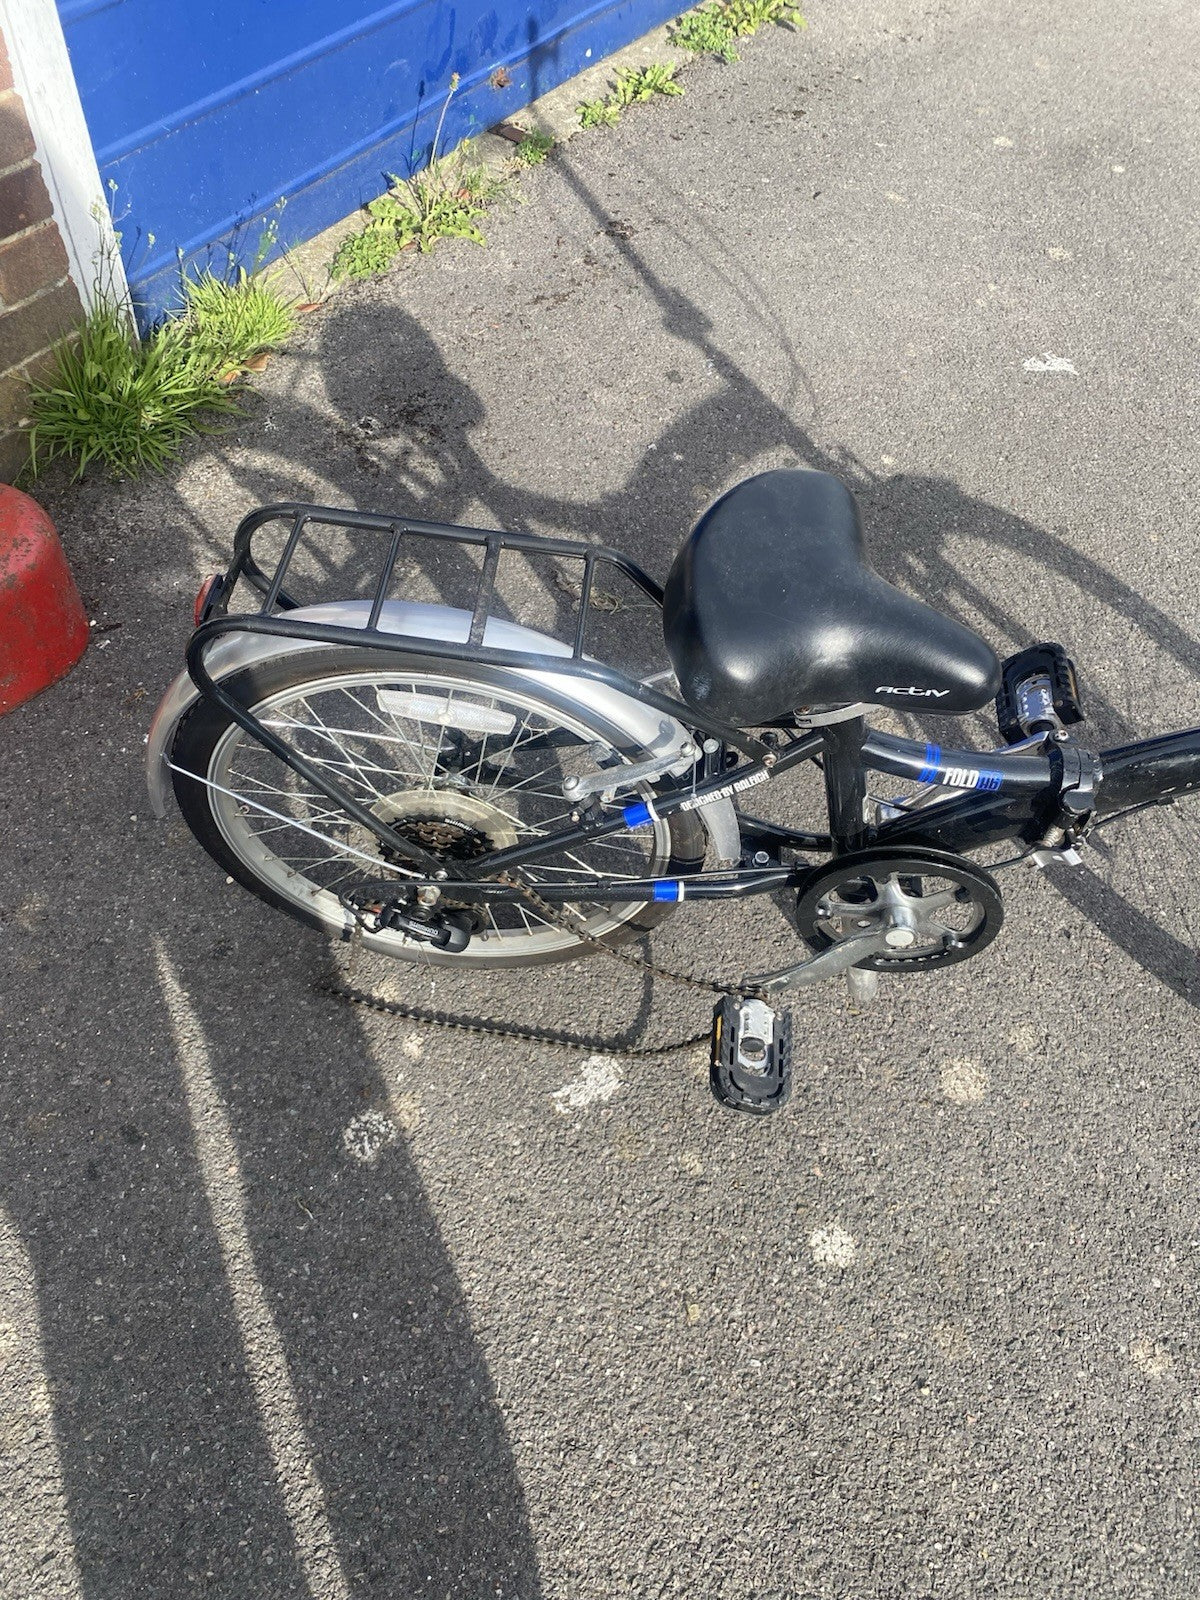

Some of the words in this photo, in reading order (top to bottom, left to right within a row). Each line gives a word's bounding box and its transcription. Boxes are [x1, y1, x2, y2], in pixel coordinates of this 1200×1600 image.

[680, 790, 722, 811] DESIGNED
[721, 785, 734, 798] BY
[733, 770, 769, 792] RALEIGH
[942, 767, 980, 788] FOLD
